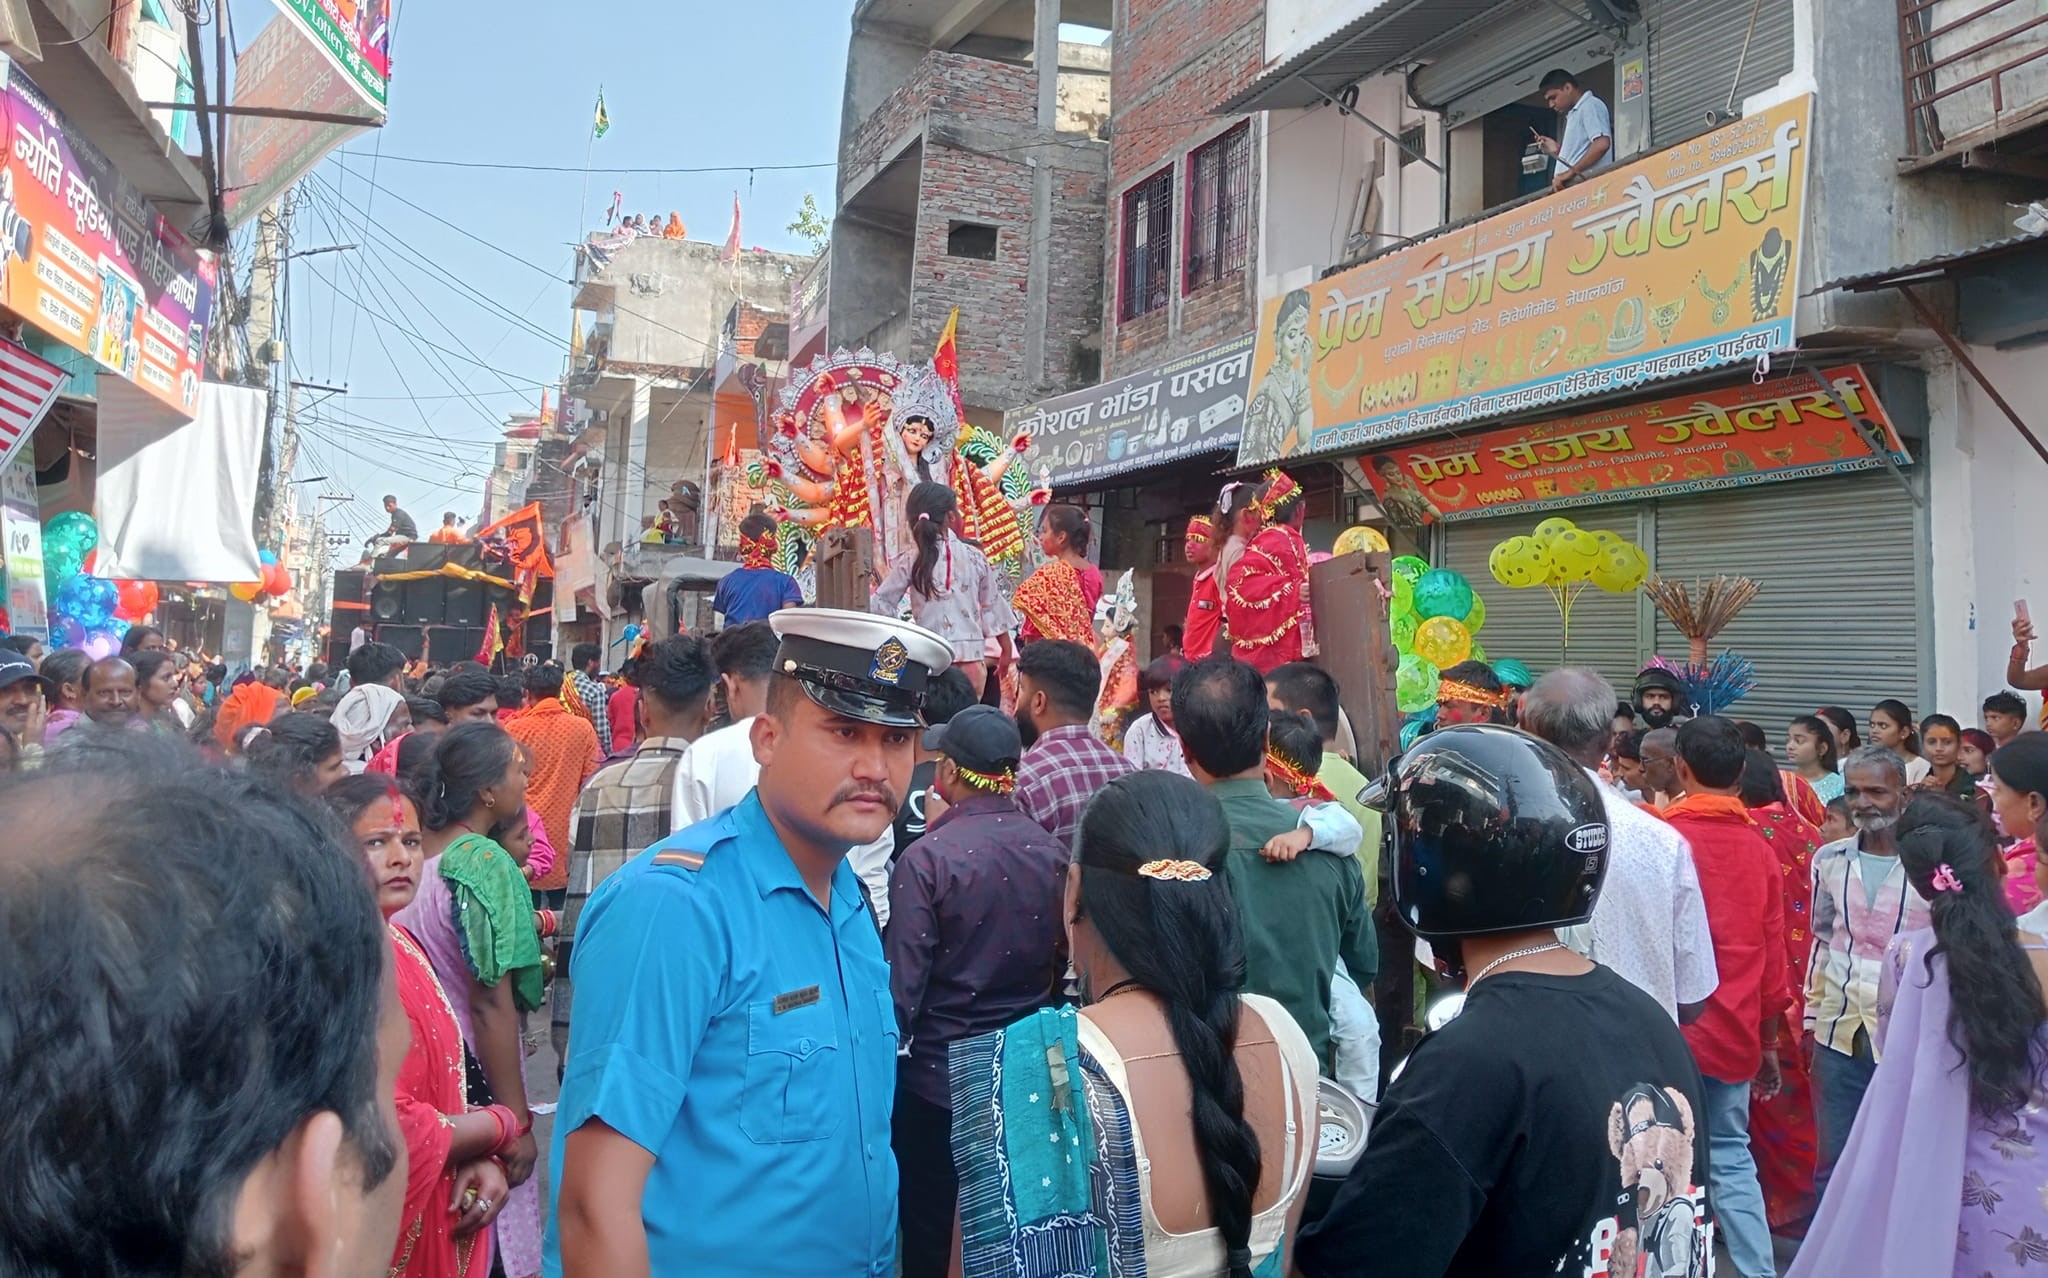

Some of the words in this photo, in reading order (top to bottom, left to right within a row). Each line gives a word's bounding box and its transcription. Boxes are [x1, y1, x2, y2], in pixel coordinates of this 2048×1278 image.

[15, 123, 64, 197] ज्योति
[1317, 287, 1392, 361] प्रेम
[1403, 229, 1553, 329] संजय
[1567, 119, 1801, 276] ज्वैलर्स
[1558, 195, 1588, 216] पसल
[1384, 339, 1412, 364] पुरानो
[1565, 277, 1626, 306] नेपालगंज
[1018, 402, 1094, 437] कौशल
[1099, 381, 1163, 419] भाँडा
[1170, 349, 1252, 397] पसल
[1315, 430, 1338, 449] हामी
[1363, 415, 1404, 439] आकर्षक
[1468, 396, 1495, 416] बिना
[1498, 381, 1560, 409] रसायनका
[1563, 367, 1614, 393] रेडिमेड
[1716, 328, 1771, 359] पाईन्छ
[1408, 447, 1485, 486] प्रेम
[1490, 423, 1635, 469] संजय
[1645, 376, 1866, 443] ज्वैलर्स
[1674, 440, 1729, 457] नेपालगंज
[1576, 827, 1606, 850] STUDDS
